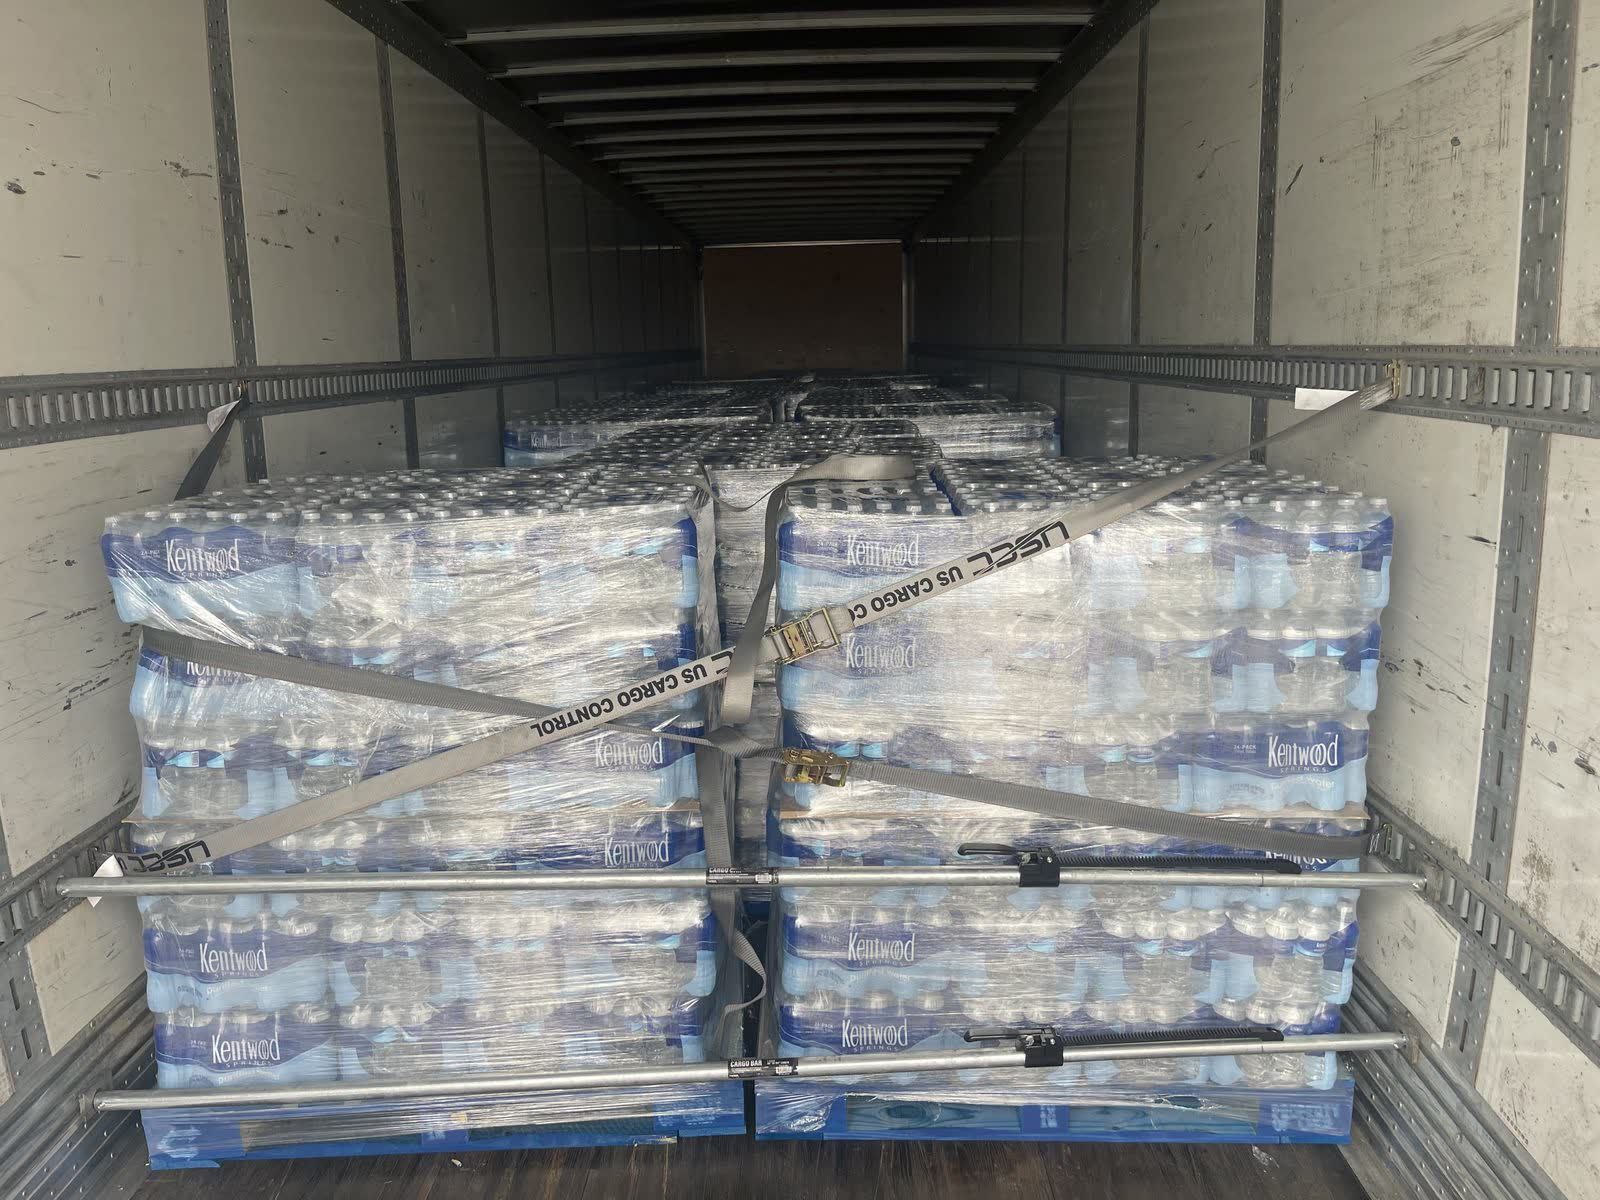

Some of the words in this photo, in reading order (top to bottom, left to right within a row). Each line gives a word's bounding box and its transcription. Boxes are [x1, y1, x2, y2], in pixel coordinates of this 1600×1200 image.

[165, 538, 240, 573] Kentwood
[847, 533, 919, 566] Kentwood
[936, 566, 964, 587] US
[870, 577, 934, 612] CARGO
[845, 635, 916, 669] Kentwood
[617, 674, 679, 707] CARGO
[681, 664, 708, 684] US
[530, 699, 615, 737] CONTROL
[595, 737, 663, 767] Kentwood
[1268, 734, 1339, 768] Kentwood
[1280, 766, 1329, 774] SPRINGS
[604, 831, 670, 866] Kentwood
[199, 942, 268, 973] Kentwood
[847, 932, 915, 962] Kentwood
[211, 1031, 281, 1064] Kentwood
[841, 1018, 908, 1048] Kentwood
[730, 1060, 749, 1068] CARGO
